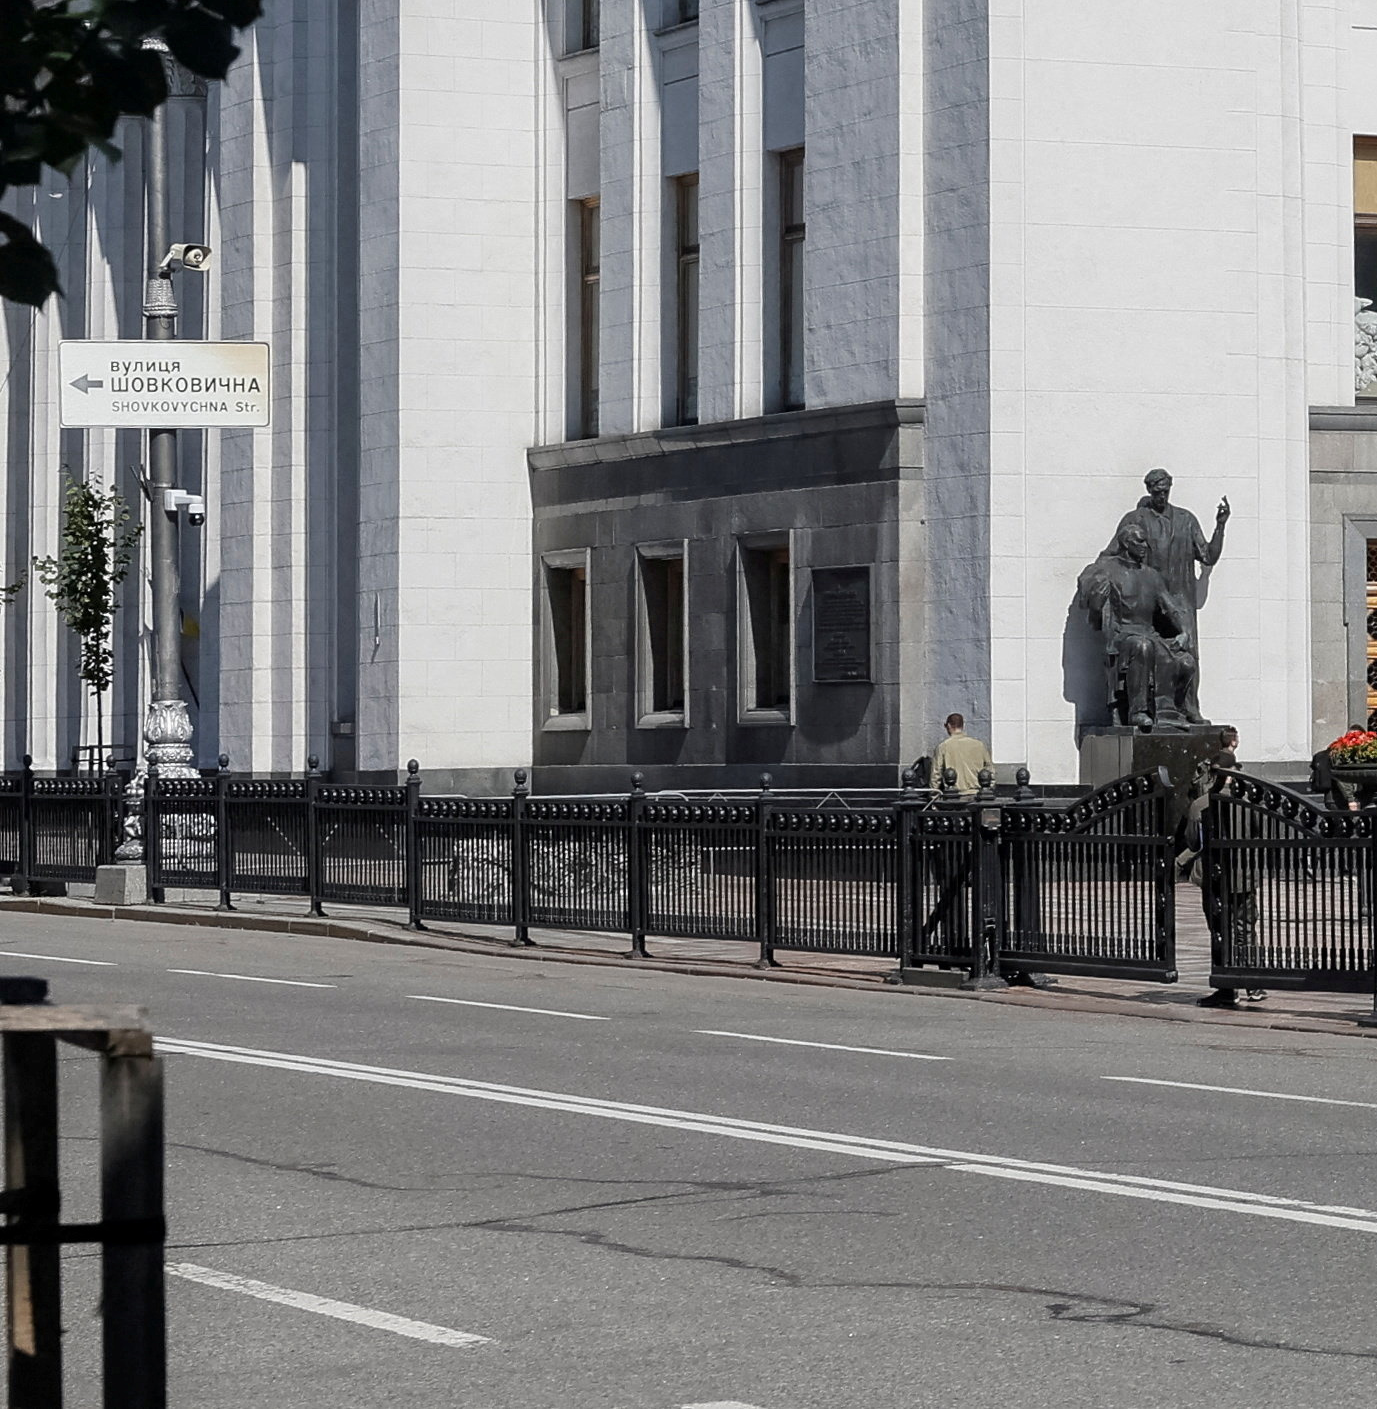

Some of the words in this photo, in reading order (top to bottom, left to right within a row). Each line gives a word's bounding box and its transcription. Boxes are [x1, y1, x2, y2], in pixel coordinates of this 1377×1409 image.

[110, 360, 181, 376] вулиця
[110, 377, 261, 393] ШОВКОВИЧНА
[111, 401, 228, 413] SHOVKOVYCHNA
[235, 401, 260, 413] Str.
